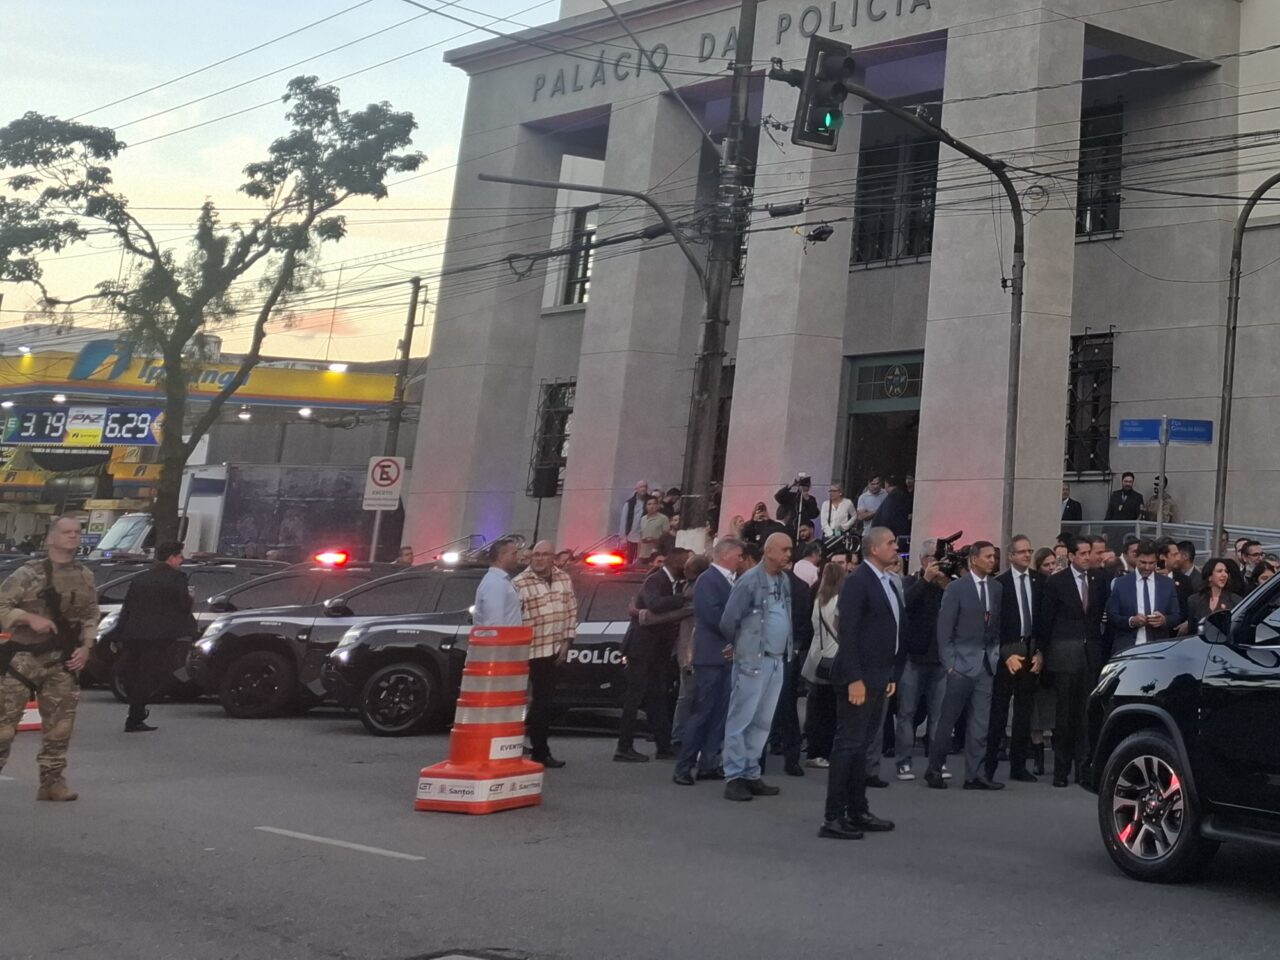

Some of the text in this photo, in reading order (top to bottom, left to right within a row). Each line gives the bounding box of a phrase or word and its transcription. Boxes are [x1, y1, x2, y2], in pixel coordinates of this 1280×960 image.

[532, 41, 668, 102] PALÁCIO
[698, 25, 740, 63] DA
[20, 412, 66, 438] 3.79
[105, 413, 151, 438] 6.29
[566, 646, 622, 664] POLÍC
[449, 787, 474, 797] Santos
